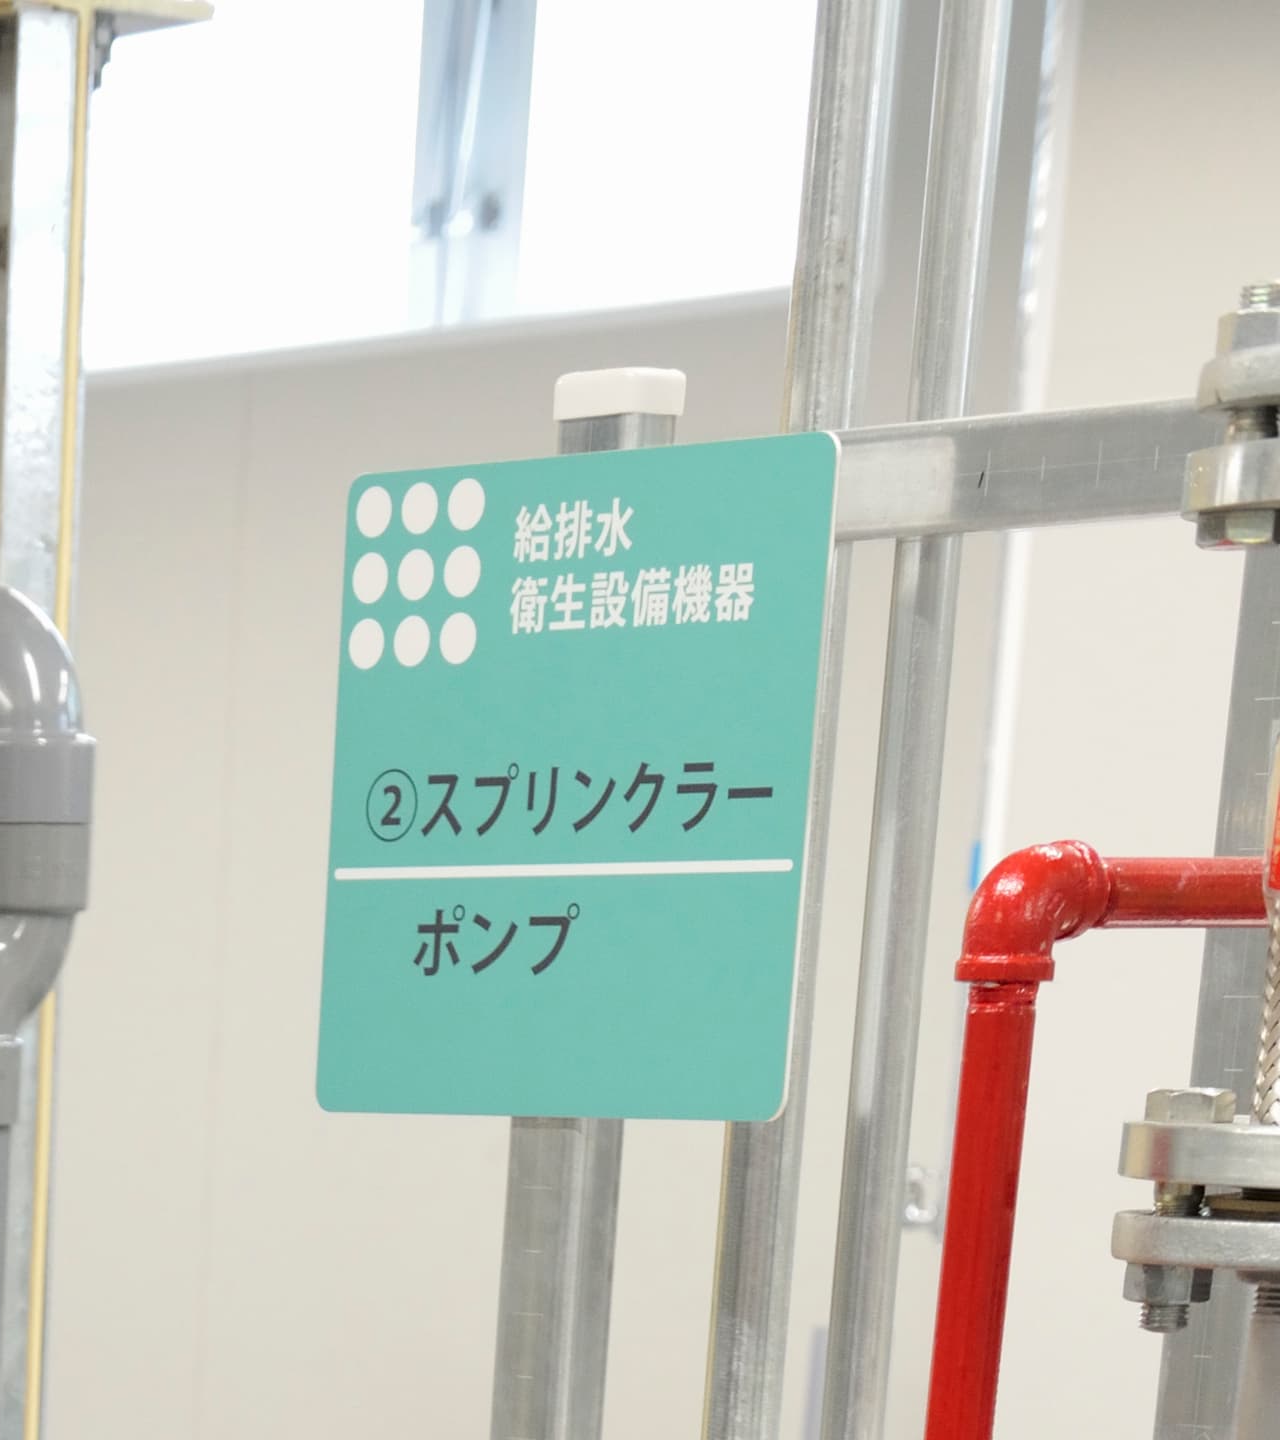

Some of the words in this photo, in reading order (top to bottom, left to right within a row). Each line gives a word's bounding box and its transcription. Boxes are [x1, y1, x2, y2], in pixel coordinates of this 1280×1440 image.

[513, 497, 634, 564] 給排水
[510, 563, 755, 634] 衛生設備機器
[366, 760, 774, 842] ②スプリンクラー
[413, 902, 581, 977] ポンプ
